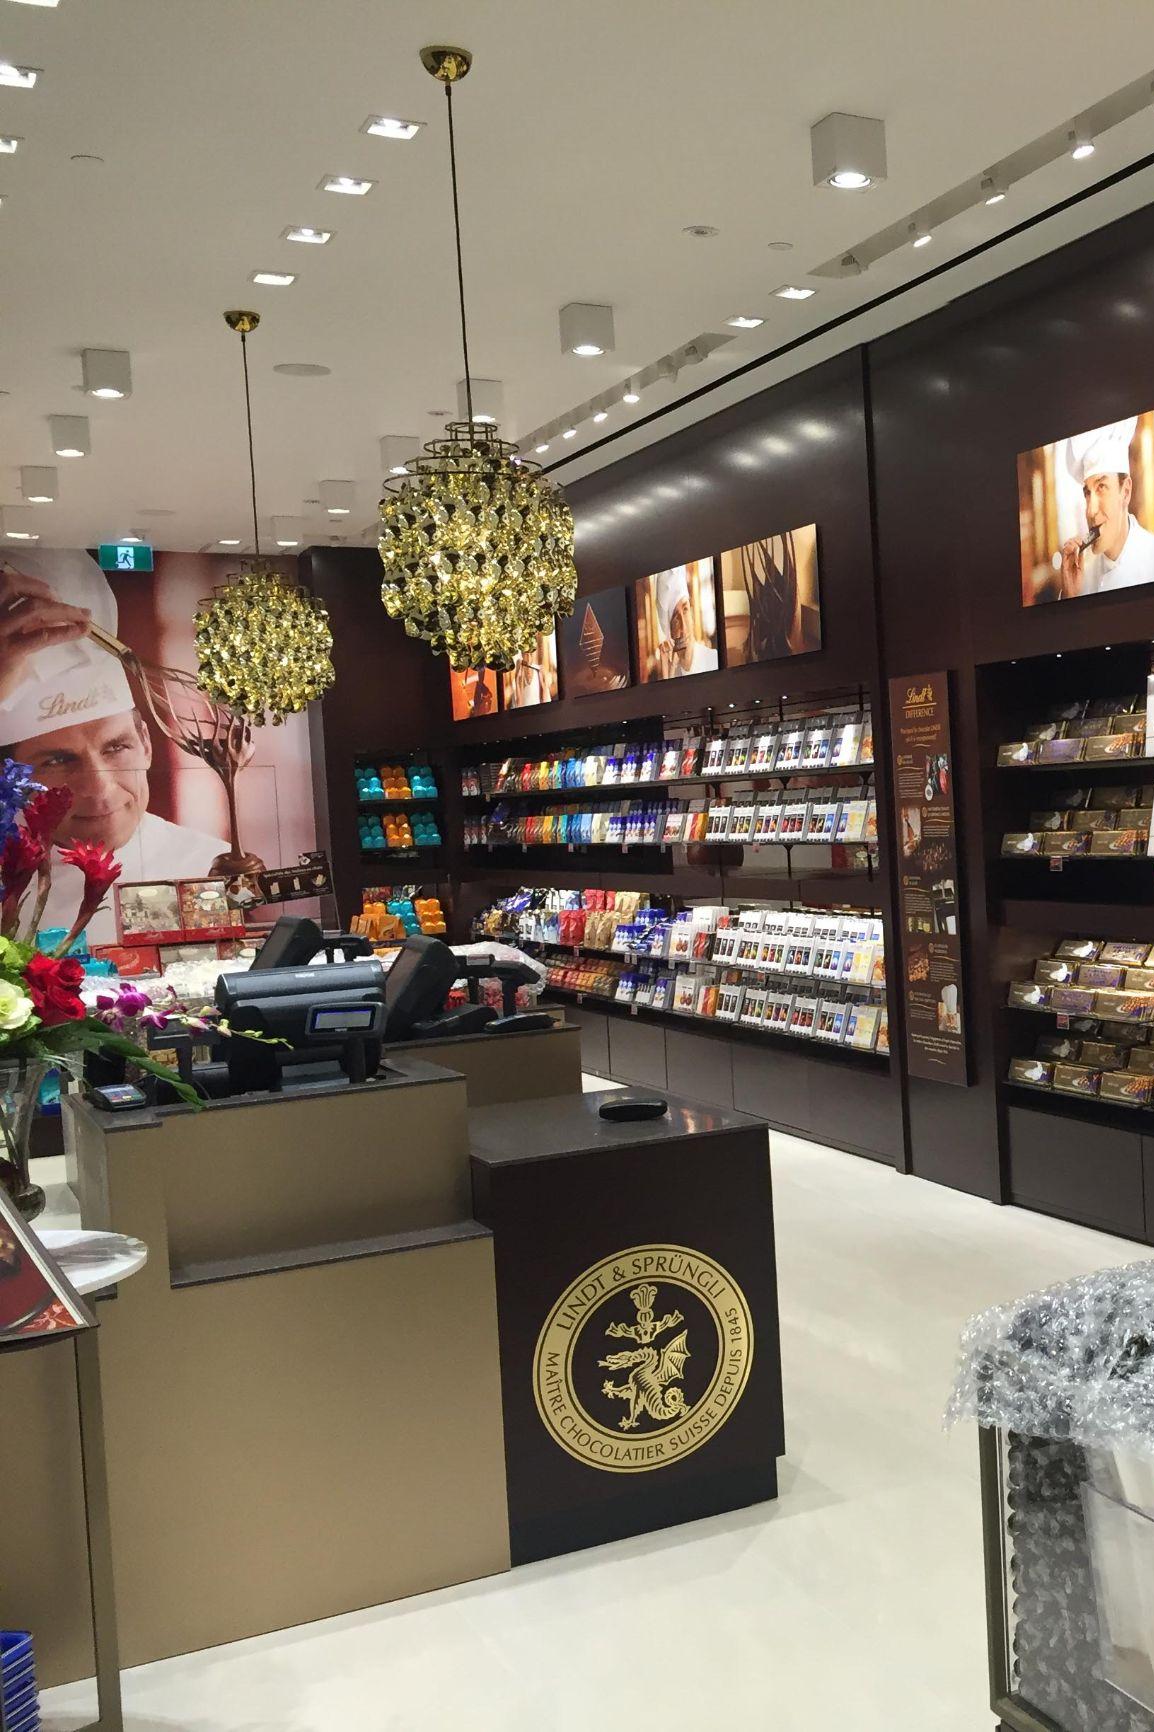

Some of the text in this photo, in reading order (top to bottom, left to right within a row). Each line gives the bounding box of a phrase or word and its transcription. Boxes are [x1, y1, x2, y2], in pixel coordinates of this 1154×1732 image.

[905, 687, 927, 704] Lindt
[556, 1254, 726, 1330] LINDT & SPRÜNGLI
[544, 1307, 742, 1461] MAÎTRE CHOCOLATIER SUISSE DEPUIS 1845
